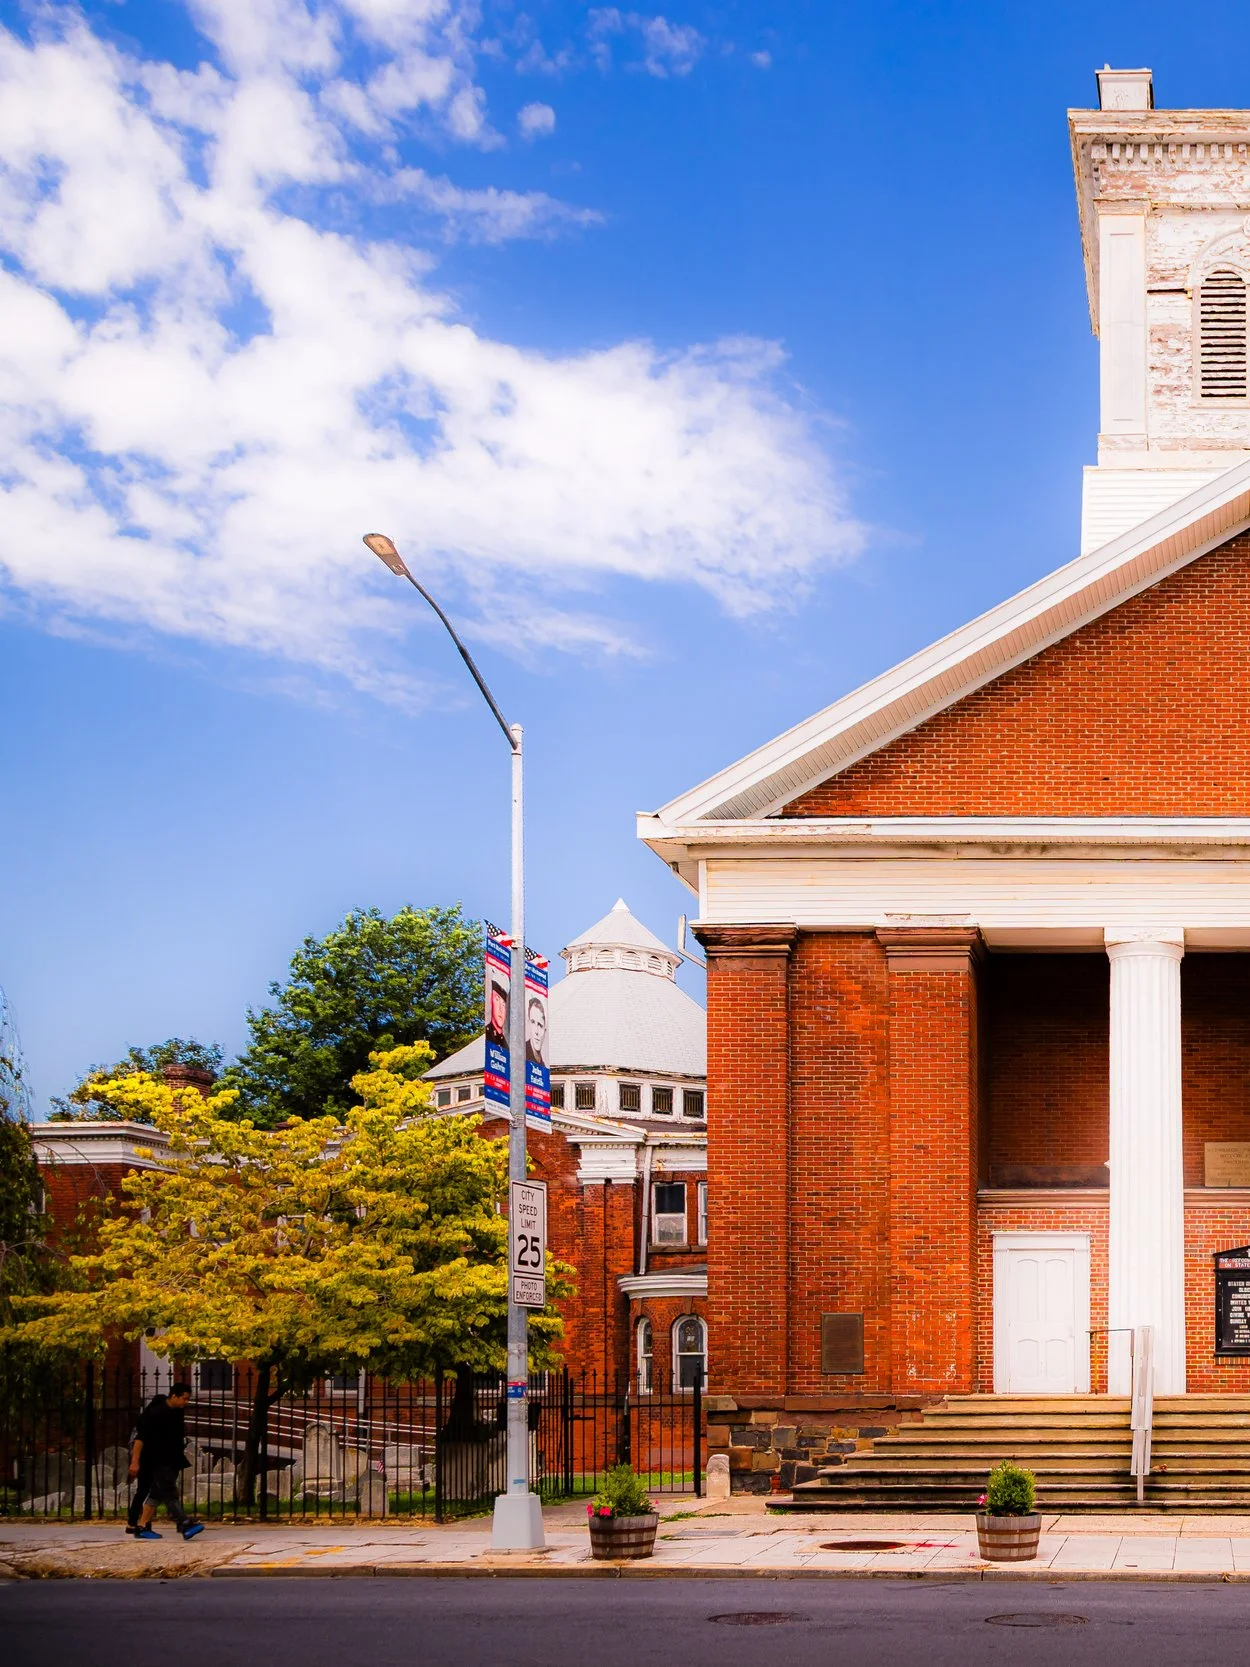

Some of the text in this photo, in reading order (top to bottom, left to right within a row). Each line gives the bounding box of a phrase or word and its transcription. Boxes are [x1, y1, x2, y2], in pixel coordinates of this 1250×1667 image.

[521, 1189, 535, 1201] CITY
[518, 1203, 538, 1217] SPEED
[520, 1218, 536, 1230] LIMIT
[517, 1233, 541, 1268] 25
[520, 1280, 538, 1292] PHOTO
[515, 1290, 543, 1302] ENFORCED
